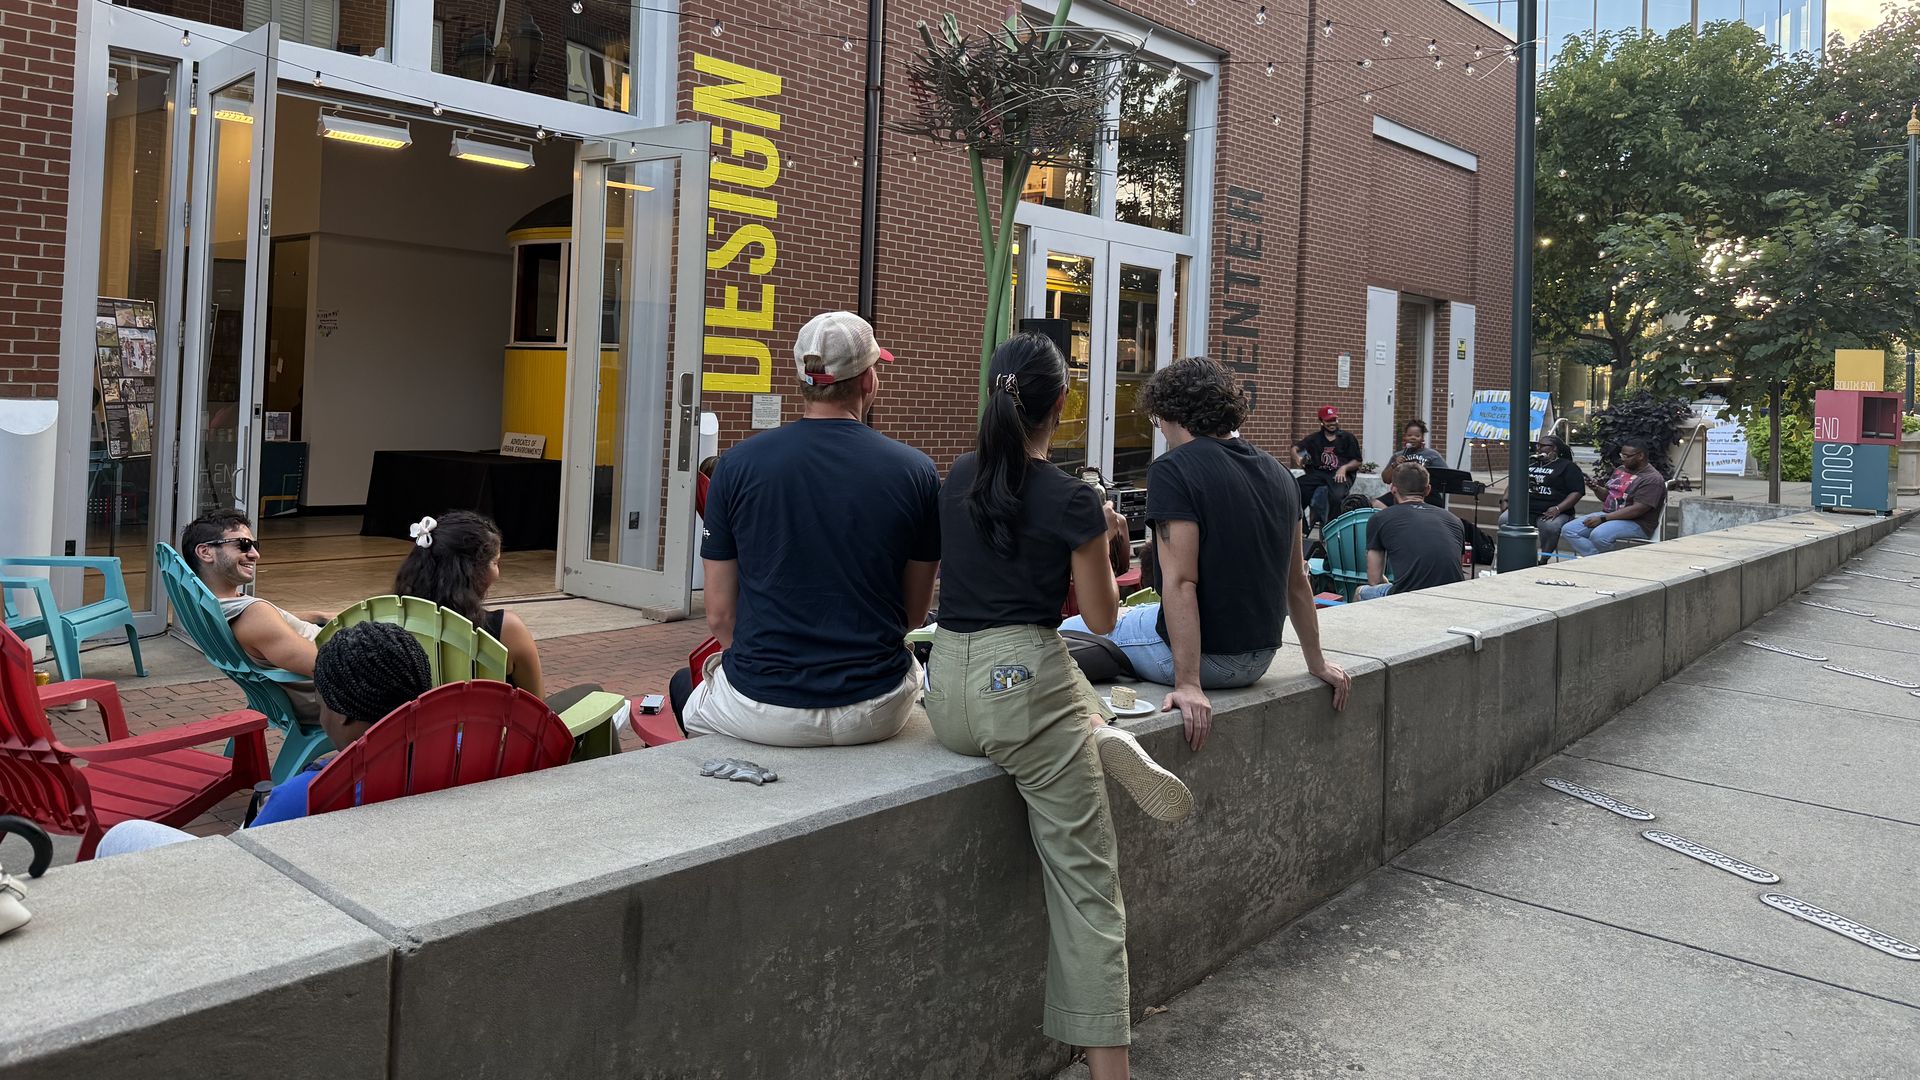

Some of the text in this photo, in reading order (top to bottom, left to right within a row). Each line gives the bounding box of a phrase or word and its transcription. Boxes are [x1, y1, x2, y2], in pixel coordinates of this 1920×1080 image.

[692, 52, 782, 393] DESIGN
[1835, 381, 1876, 391] SOUTH END
[1814, 416, 1839, 440] END
[1820, 444, 1854, 507] SOUTH
